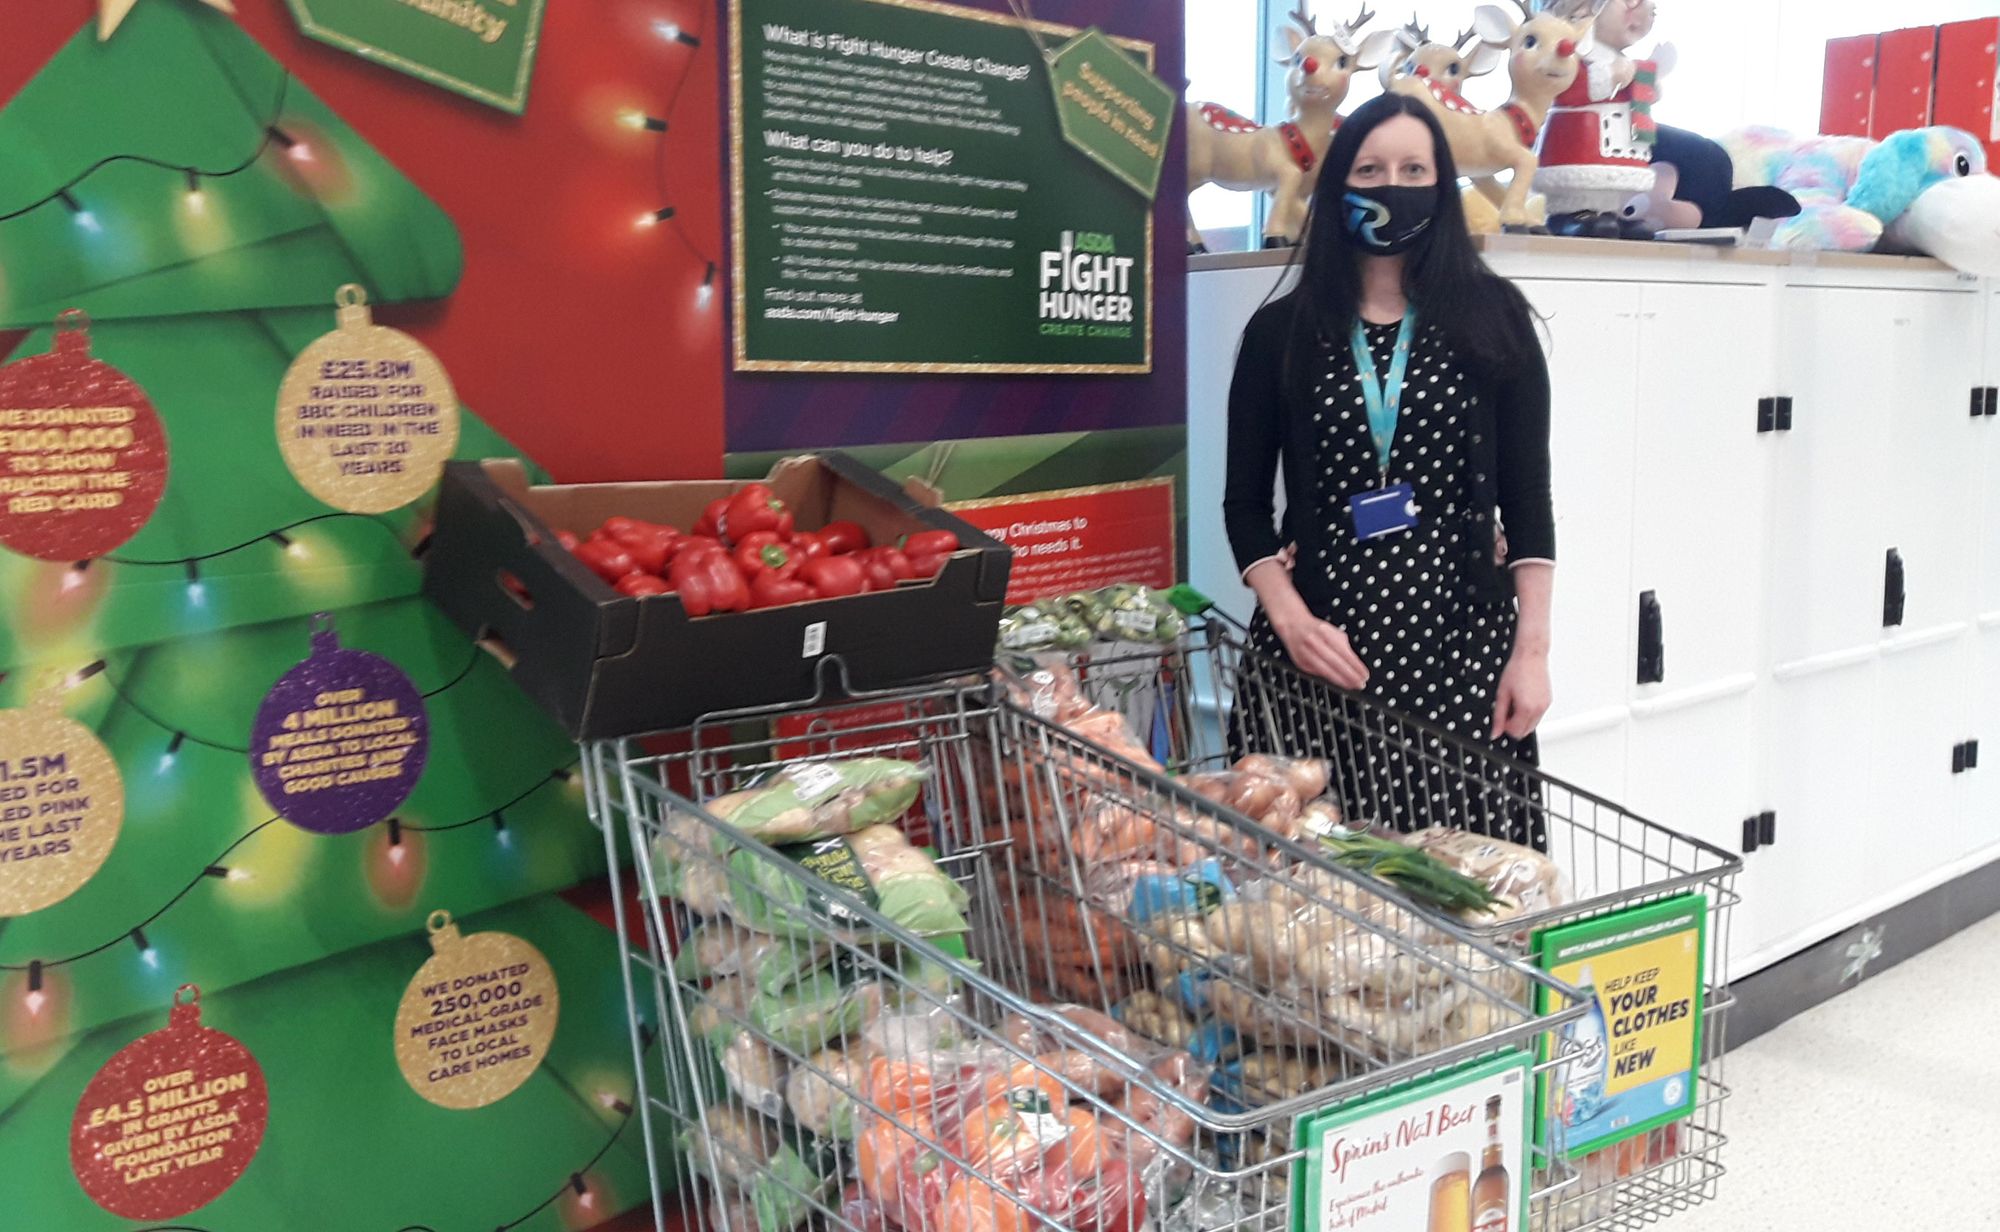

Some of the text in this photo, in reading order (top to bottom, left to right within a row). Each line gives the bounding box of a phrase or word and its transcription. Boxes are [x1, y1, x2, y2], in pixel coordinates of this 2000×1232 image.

[762, 23, 809, 47] What
[811, 31, 825, 49] is
[827, 34, 869, 56] Fight
[870, 41, 925, 64] Hunger
[925, 49, 973, 71] Create
[973, 57, 1031, 81] Change?
[762, 129, 954, 168] What can you do to help?
[1075, 231, 1115, 253] ASDA
[1040, 230, 1134, 293] FIGHT
[764, 287, 794, 302] Find
[795, 290, 817, 302] out
[817, 292, 848, 304] more
[1040, 291, 1133, 321] HUNGER
[764, 305, 900, 324] asda.com/fight-hunger
[1040, 323, 1132, 338] CREATE CHANGE
[311, 385, 425, 399] RAISED FOR
[27, 406, 136, 425] DONATED
[299, 403, 438, 419] BBC CHILDREN
[299, 421, 440, 438] IN NEED IN THE
[8, 452, 118, 472] TO SHOW
[331, 442, 380, 457] LAST
[0, 471, 133, 493] RACISM THE
[340, 460, 405, 477] YEARS
[8, 491, 124, 514] RED CARD
[1010, 519, 1072, 538] Christmas
[1072, 516, 1087, 530] to
[1030, 539, 1069, 556] needs
[1070, 537, 1083, 551] it.
[313, 688, 366, 706] OVER
[282, 699, 398, 730] 4 MILLION
[269, 717, 411, 749] MEALS DONATED
[262, 730, 420, 766] BY ASDA TO LOCAL
[278, 746, 408, 779] CHARITIES AND
[36, 777, 79, 797] FOR
[284, 763, 404, 794] GOOD CAUSES
[40, 796, 90, 816] PINK
[28, 817, 83, 838] LAST
[0, 838, 71, 862] YEARS
[422, 963, 529, 998] WE DONATED
[1604, 967, 1659, 993] HELP KEEP
[431, 981, 522, 1017] 250,000
[1610, 985, 1658, 1016] YOUR
[410, 994, 543, 1038] MEDICAL-GRADE
[1613, 999, 1689, 1038] CLOTHES
[428, 1014, 528, 1050] FACE MASKS
[440, 1035, 518, 1062] TO LOCAL
[1614, 1038, 1637, 1056] LIKE
[428, 1045, 531, 1083] CARE HOMES
[1613, 1047, 1657, 1078] NEW
[143, 1070, 194, 1093] OVER
[89, 1072, 248, 1127] £4.5 MILLION
[122, 1099, 219, 1135] IN GRANTS
[1437, 1103, 1477, 1136] Beer
[102, 1111, 240, 1156] GIVEN BY ASDA
[113, 1128, 232, 1171] FOUNDATION
[124, 1145, 224, 1184] LAST YEAR
